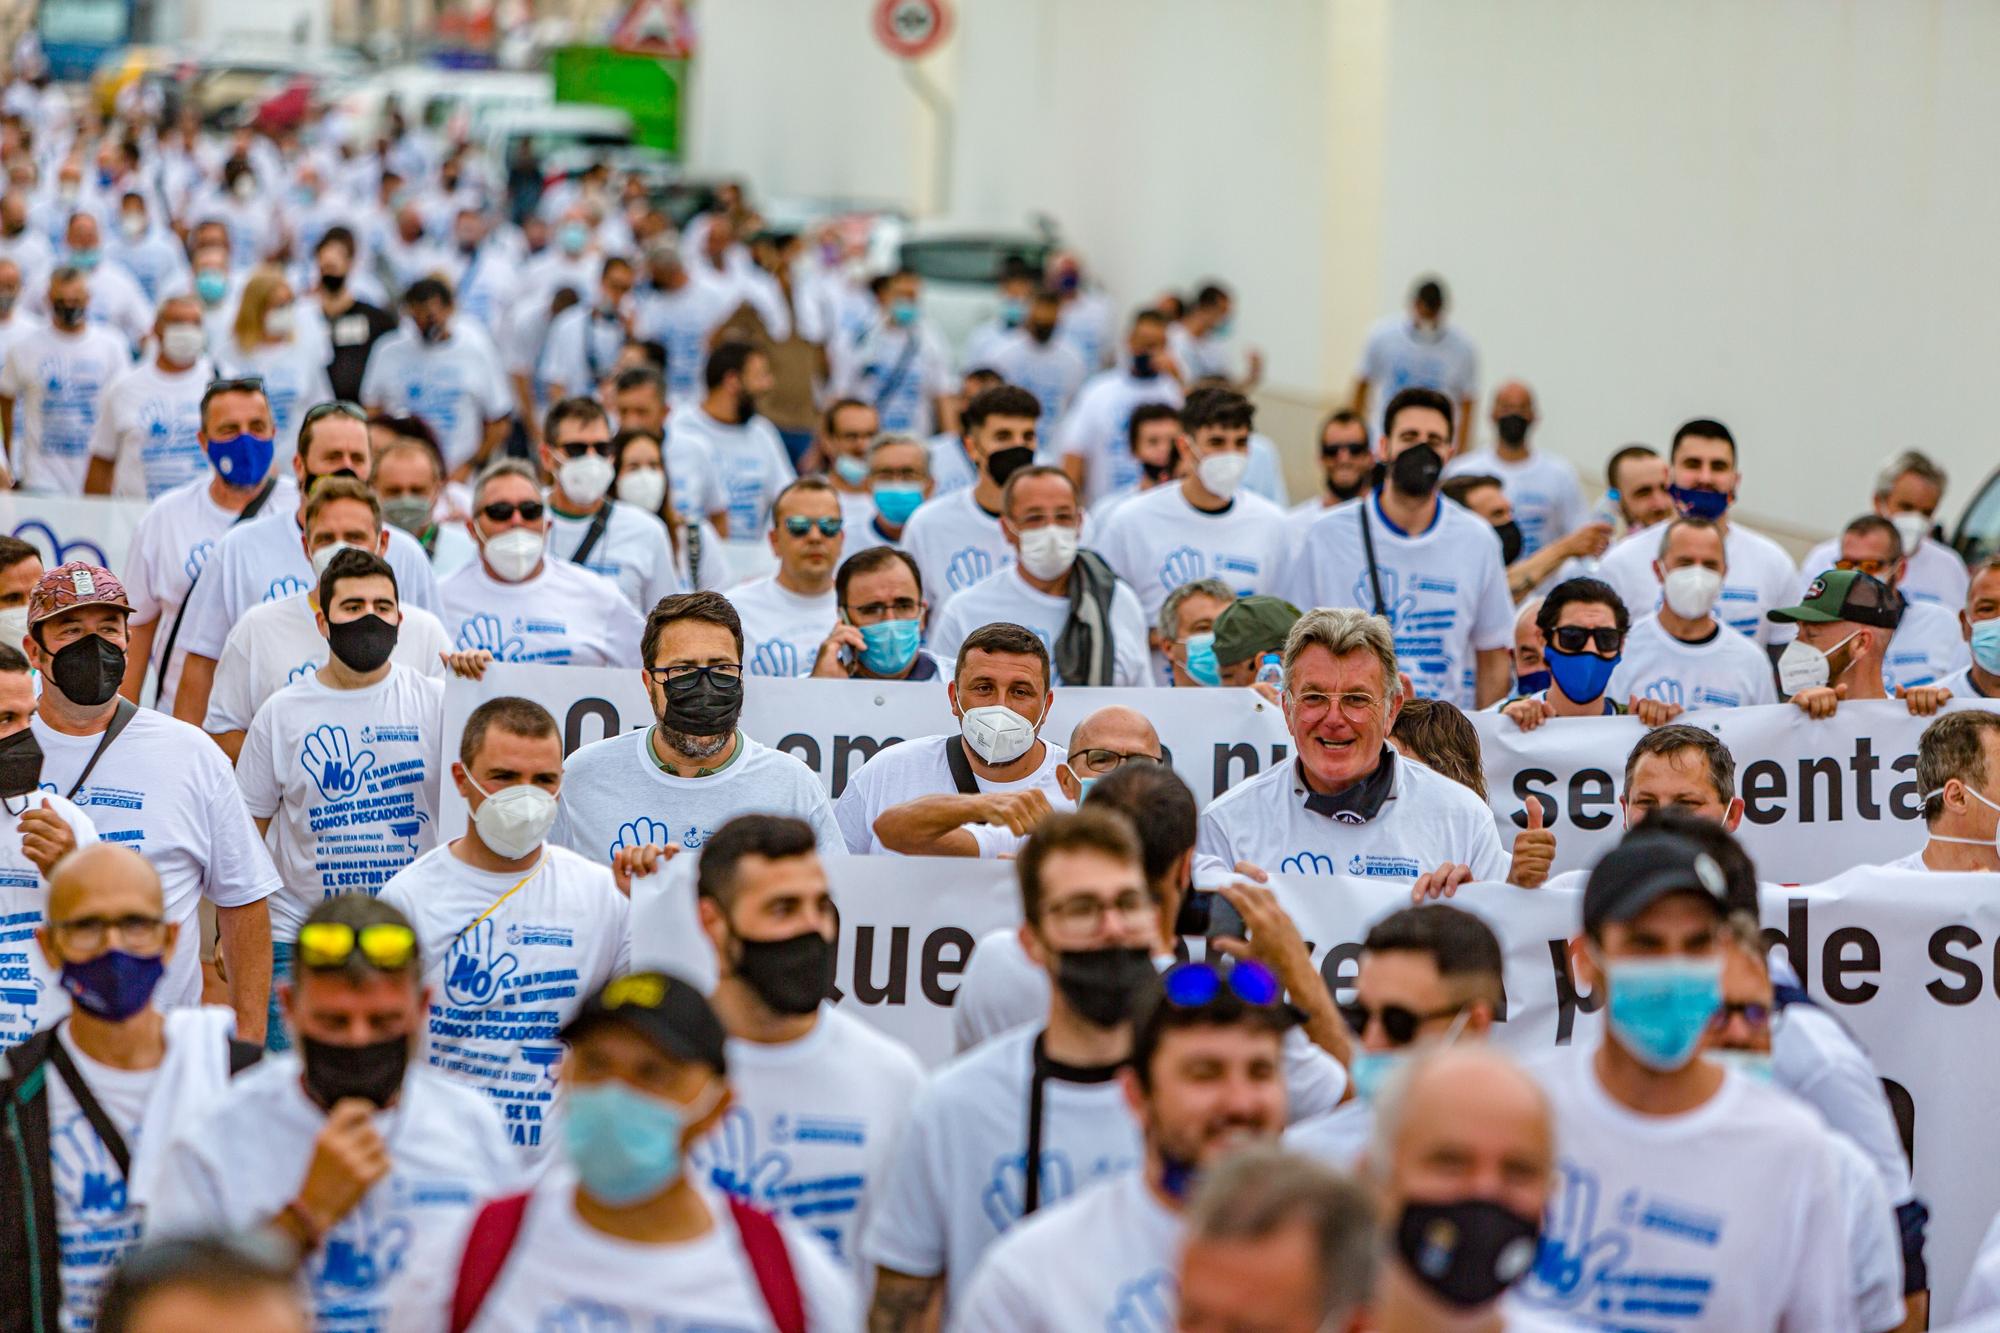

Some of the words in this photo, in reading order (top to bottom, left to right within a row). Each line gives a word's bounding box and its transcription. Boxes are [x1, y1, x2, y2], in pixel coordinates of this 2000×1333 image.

[322, 761, 355, 791] NO
[364, 770, 373, 781] AL
[372, 766, 390, 778] PLAN
[1741, 737, 1930, 826] enta
[367, 783, 380, 794] DEL
[95, 799, 138, 808] ALICANTE
[309, 807, 323, 818] NO
[324, 801, 355, 815] SOMOS
[357, 792, 415, 810] DELINCUENTES
[310, 814, 350, 832] SOMOS
[351, 804, 415, 825] PESCADORES
[322, 873, 336, 886] EL
[338, 871, 381, 885] SECTOR
[1371, 868, 1414, 876] ALICANTE
[826, 898, 976, 1008] ue
[1925, 924, 2000, 1006] s
[449, 953, 491, 998] NO
[445, 1007, 482, 1021] SOMOS
[485, 1010, 560, 1023] DELINCUENTES
[429, 1020, 473, 1039] SOMOS
[475, 1024, 561, 1040] PESCADORES
[506, 1104, 522, 1120] SE
[526, 1105, 542, 1121] VA
